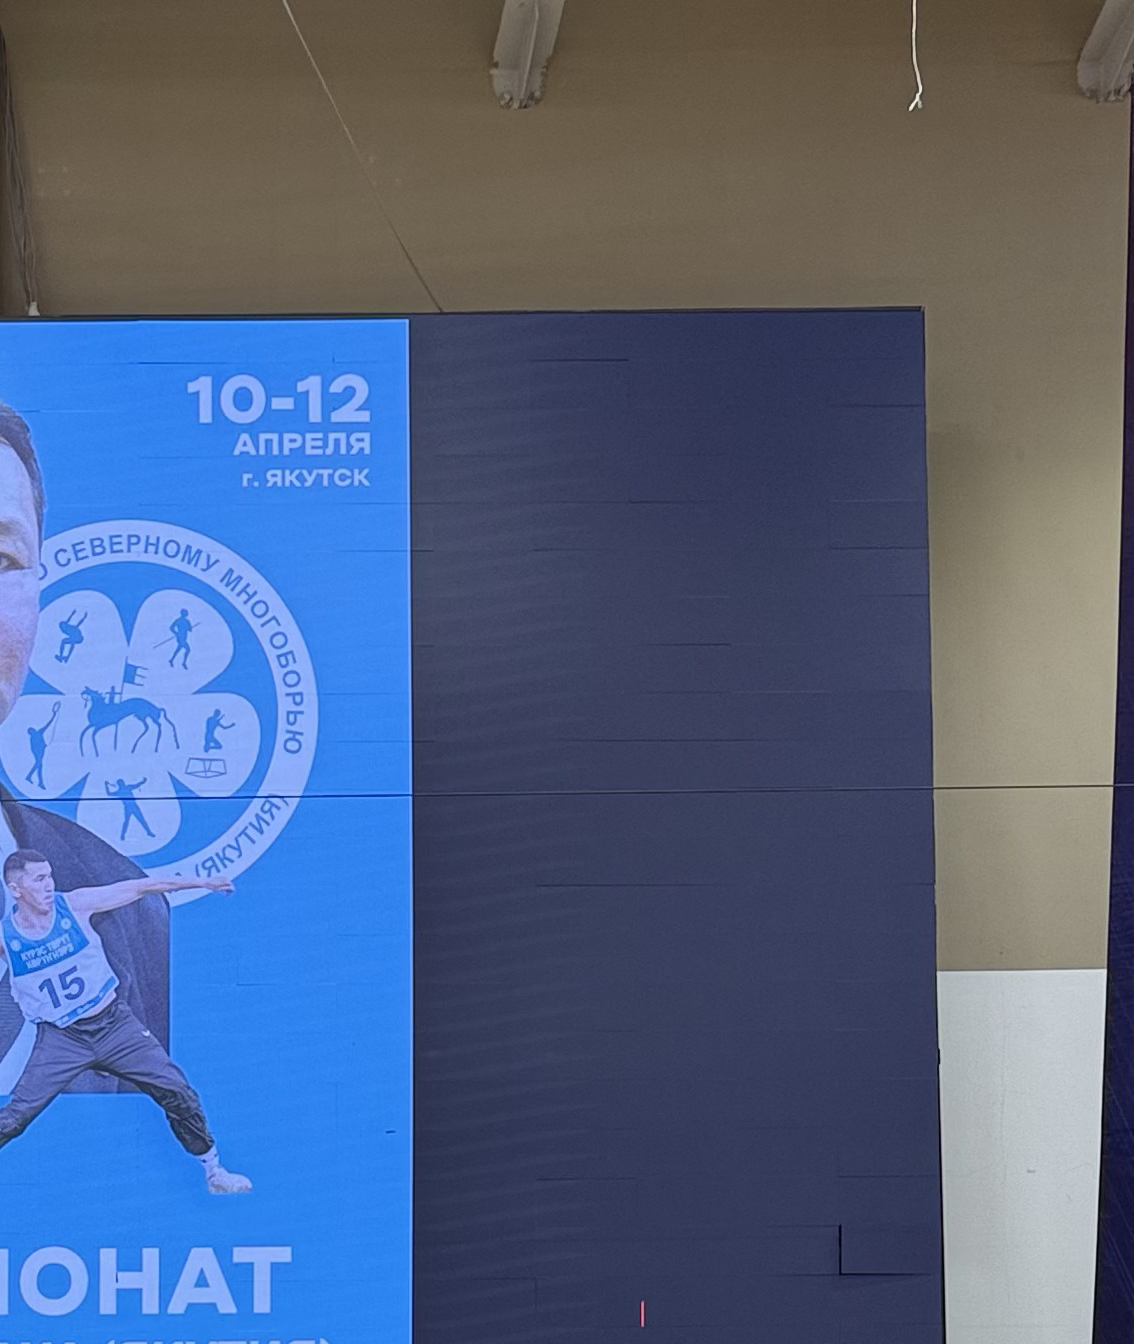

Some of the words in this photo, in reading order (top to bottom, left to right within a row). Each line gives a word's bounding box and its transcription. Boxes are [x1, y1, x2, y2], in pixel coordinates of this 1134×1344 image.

[187, 375, 372, 425] 10-12
[233, 432, 372, 457] АПРЕЛЯ
[242, 474, 261, 488] г.
[266, 469, 371, 489] ЯКУТСК
[54, 534, 220, 573] СЕВЕРНОМУ
[219, 567, 305, 755] МНОГОБОРЬЮ
[38, 966, 86, 1009] 15
